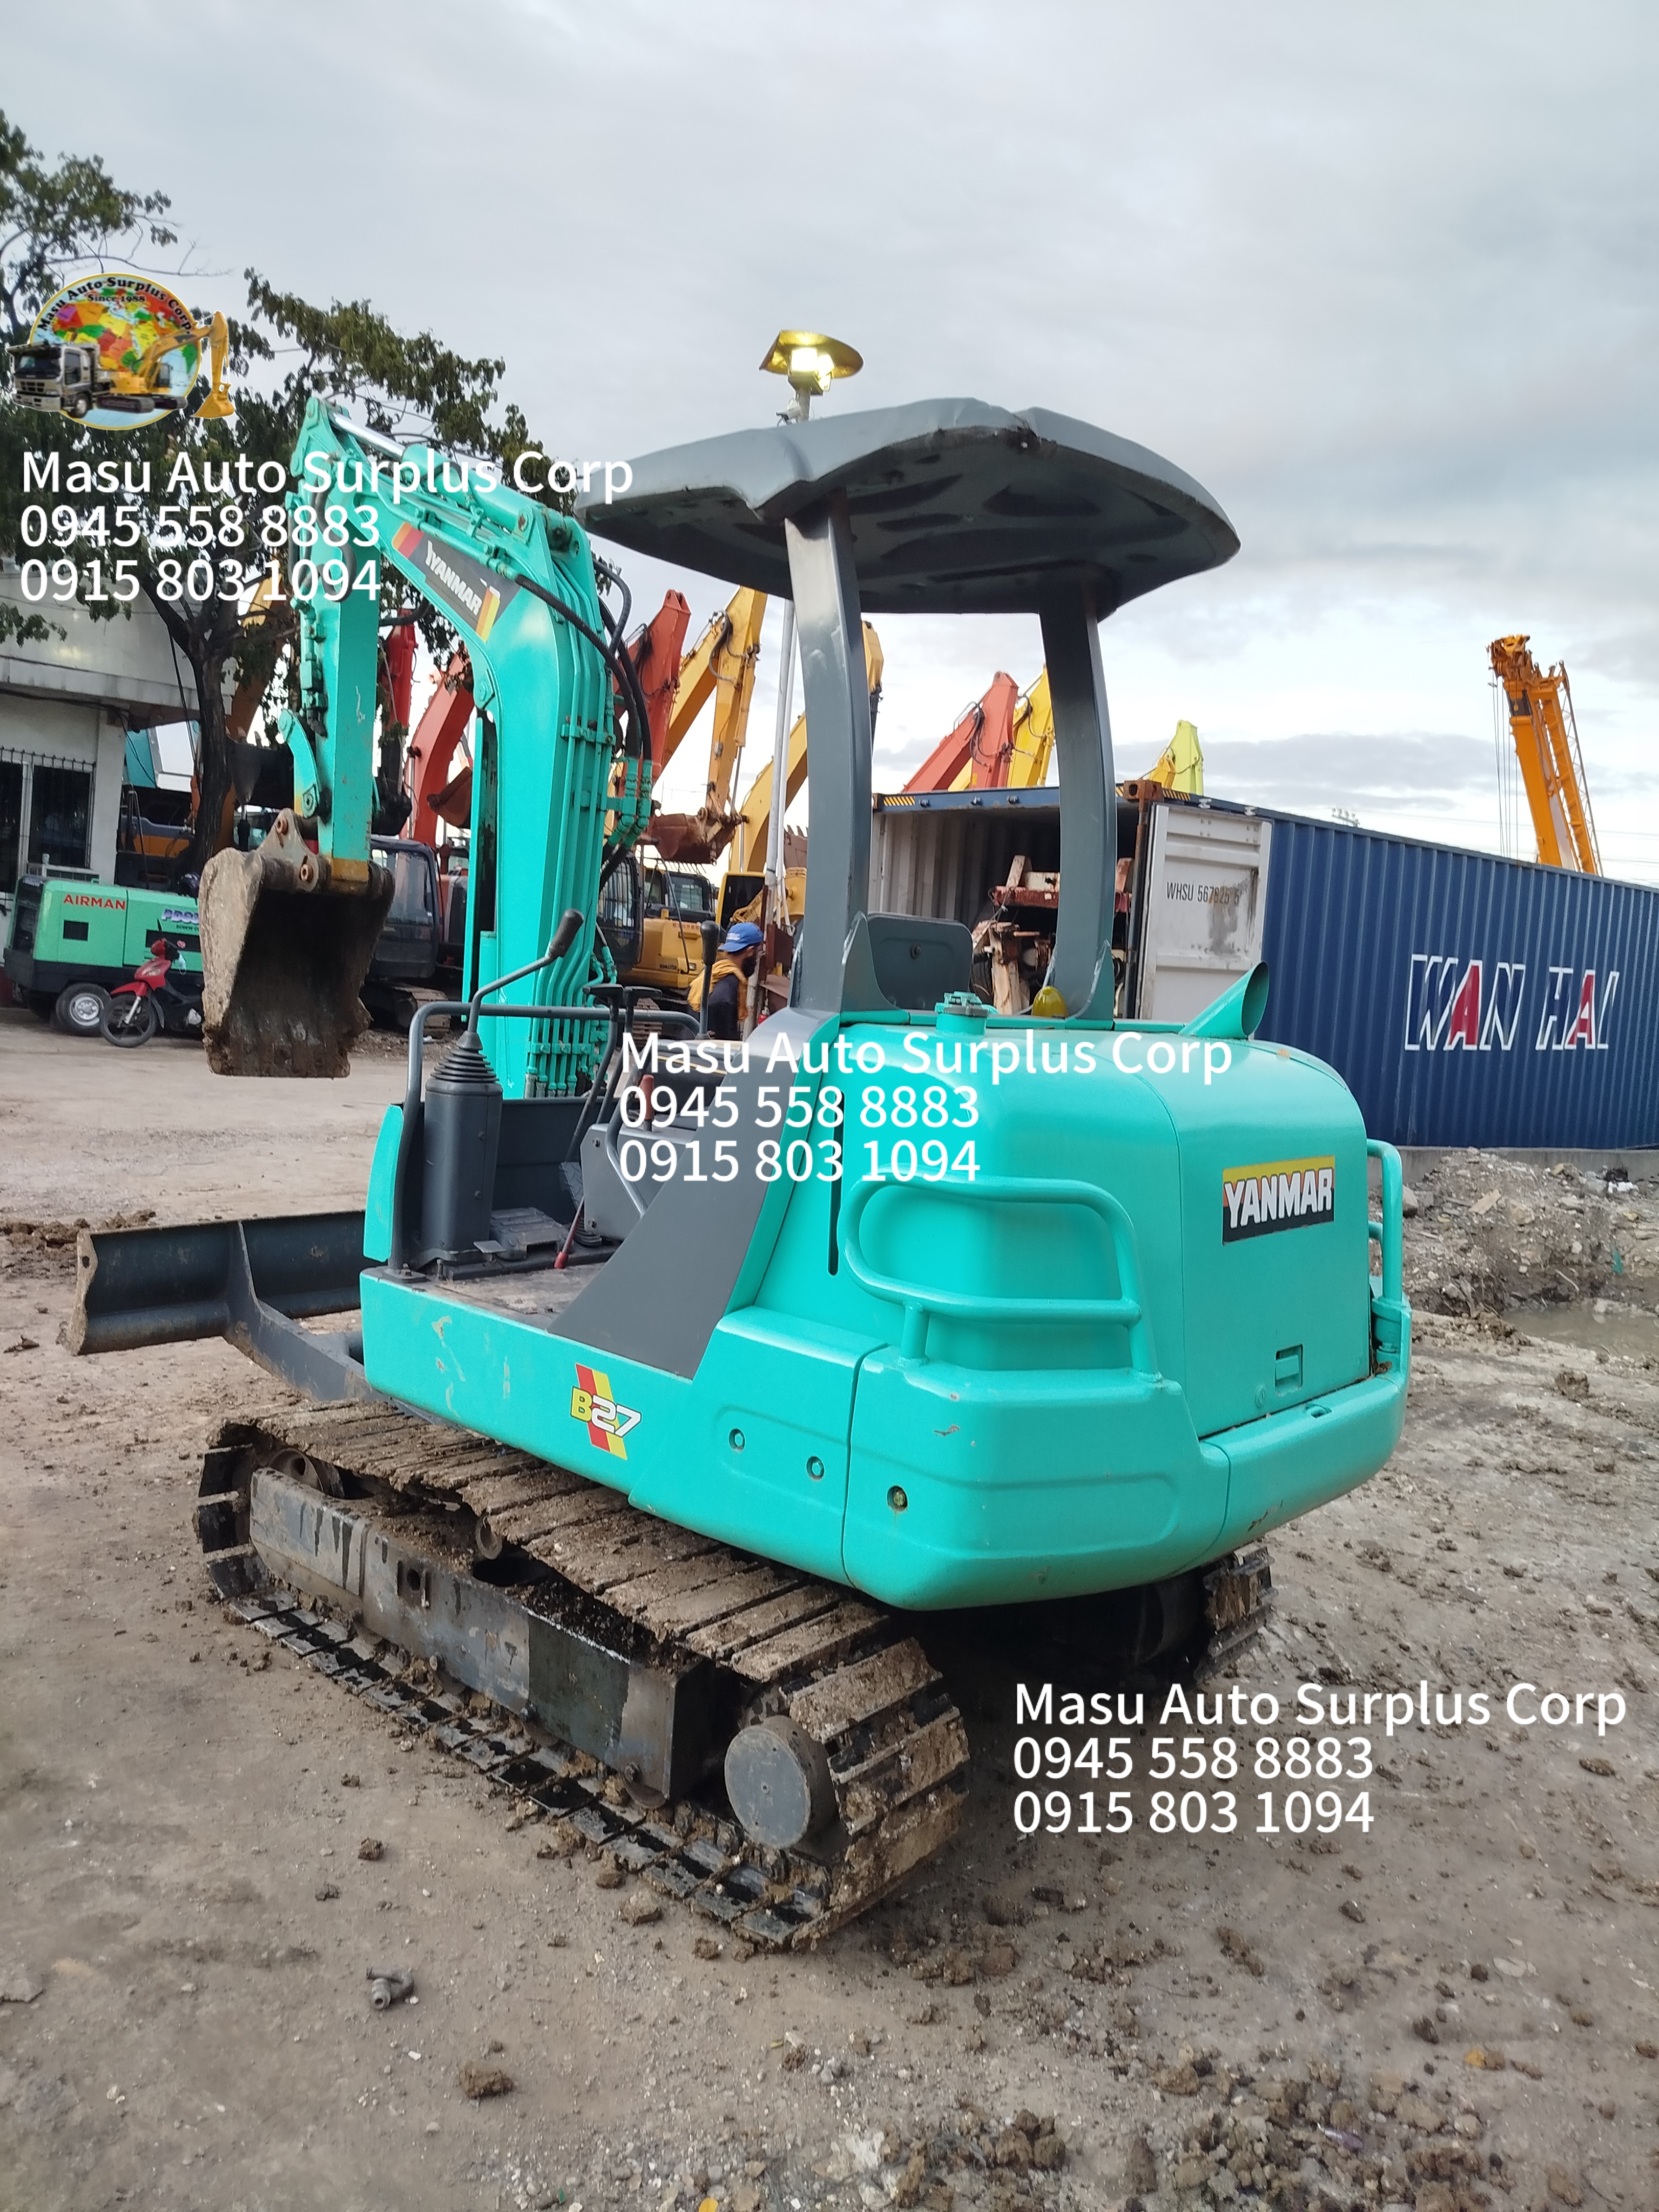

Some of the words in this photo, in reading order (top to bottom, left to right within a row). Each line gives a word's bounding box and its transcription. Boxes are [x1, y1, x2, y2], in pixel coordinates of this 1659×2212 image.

[426, 540, 483, 616] YANMAR
[63, 893, 126, 911] AIRMAN
[1166, 881, 1194, 901] WHSU
[1404, 954, 1526, 1051] WAN
[1535, 966, 1620, 1051] HAI
[1224, 1167, 1332, 1229] YANMAR
[570, 1386, 642, 1438] B27
